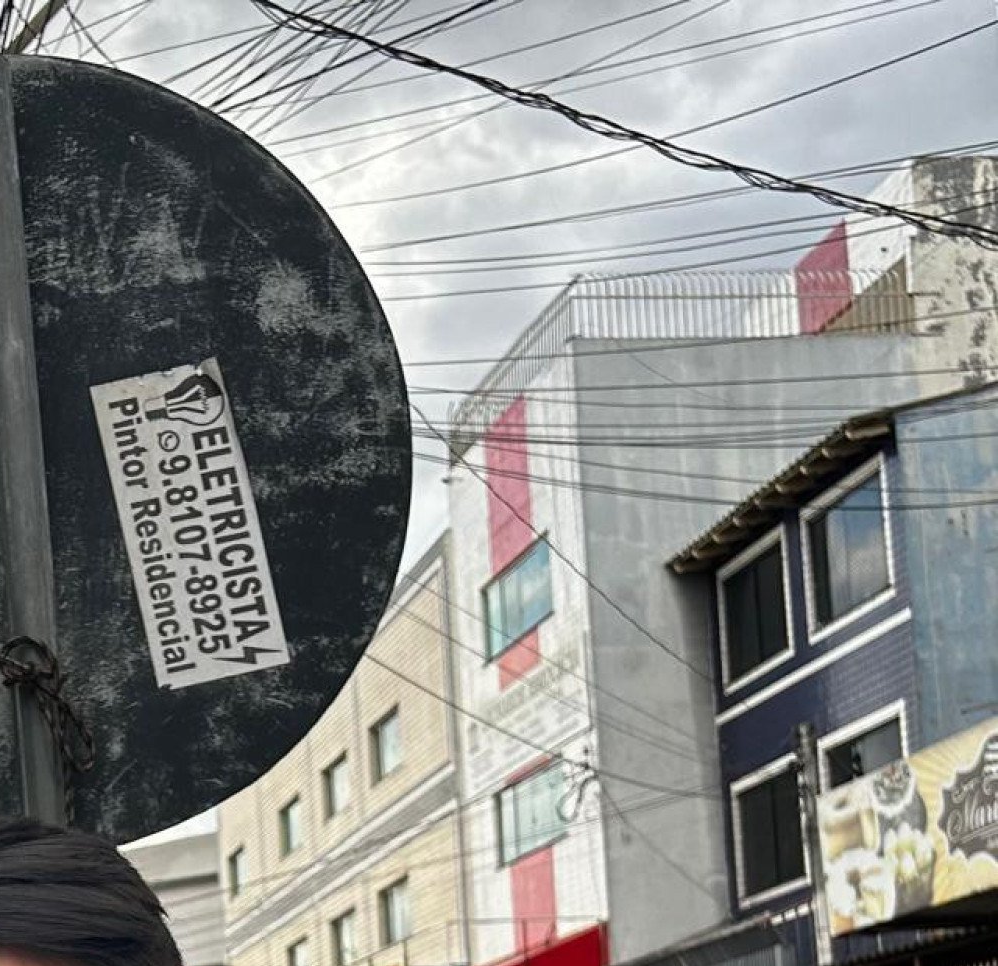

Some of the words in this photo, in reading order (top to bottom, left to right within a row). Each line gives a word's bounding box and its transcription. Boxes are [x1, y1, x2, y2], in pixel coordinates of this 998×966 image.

[108, 397, 149, 489] Pintor
[130, 497, 196, 674] Residencial
[158, 453, 232, 655] 9.8107-8925
[191, 425, 271, 643] ELETRICISTA
